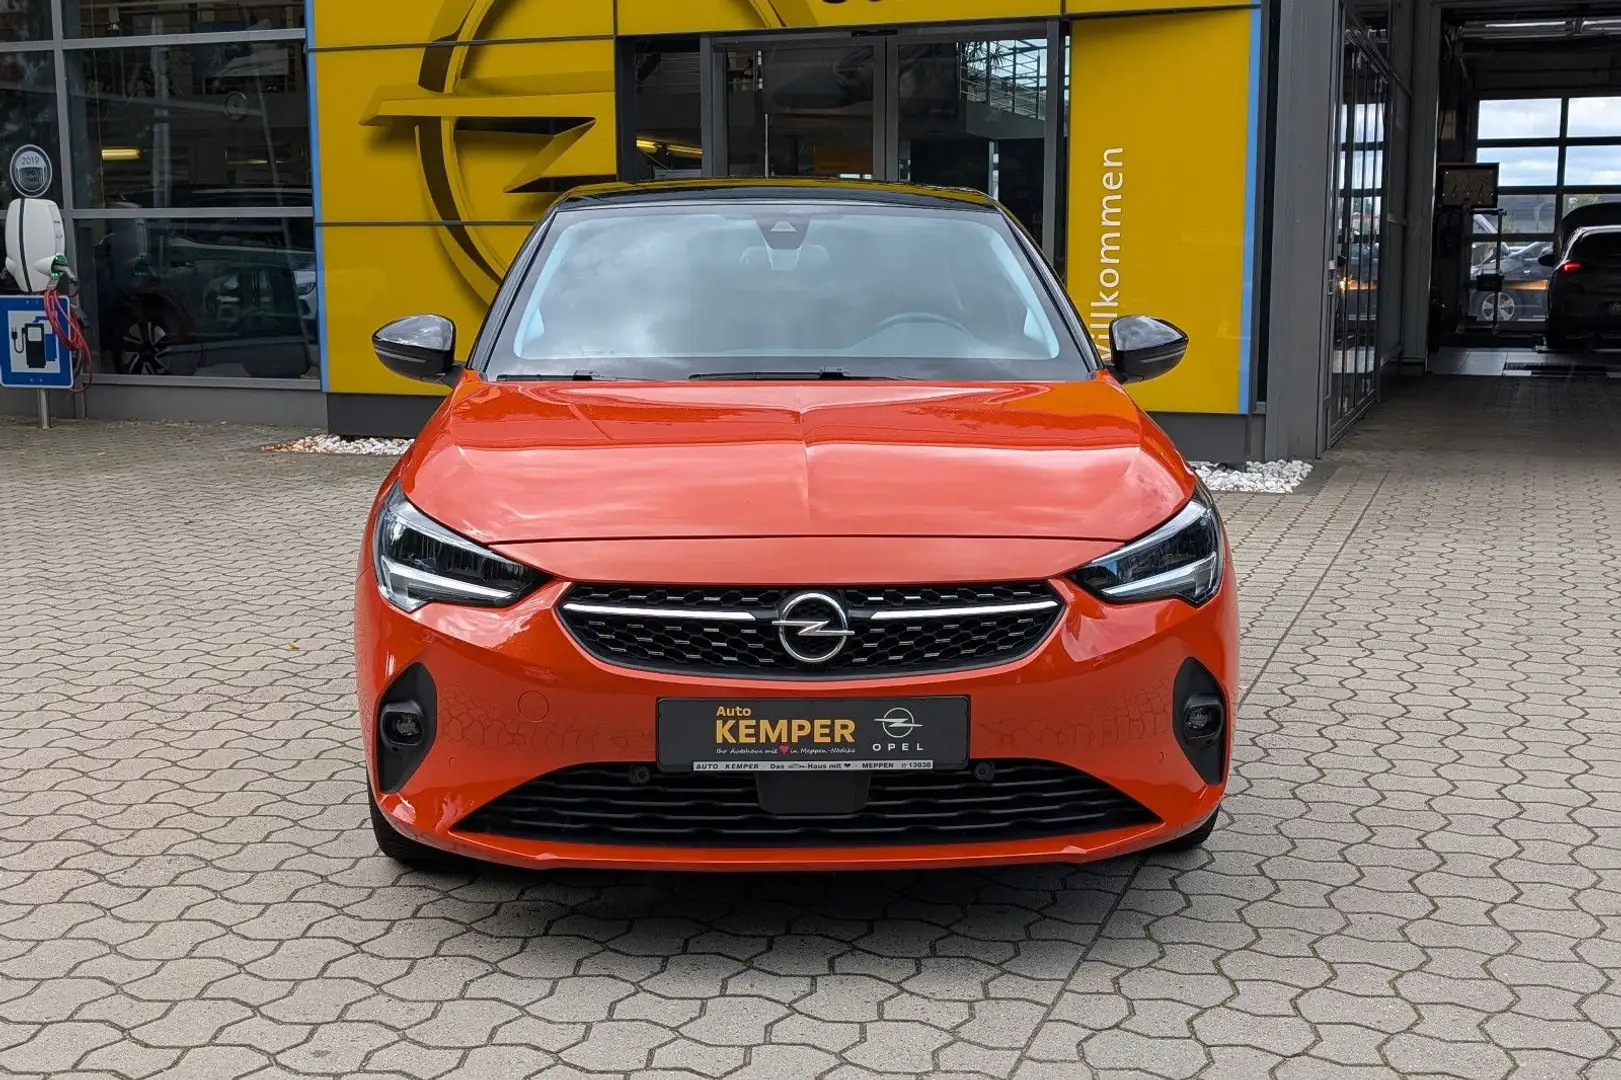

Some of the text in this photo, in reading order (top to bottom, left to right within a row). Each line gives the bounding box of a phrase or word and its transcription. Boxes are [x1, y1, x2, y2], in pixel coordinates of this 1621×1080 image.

[21, 156, 40, 165] 2019
[716, 706, 752, 717] Auto
[716, 719, 855, 744] KEMPER
[872, 743, 924, 751] OPEL
